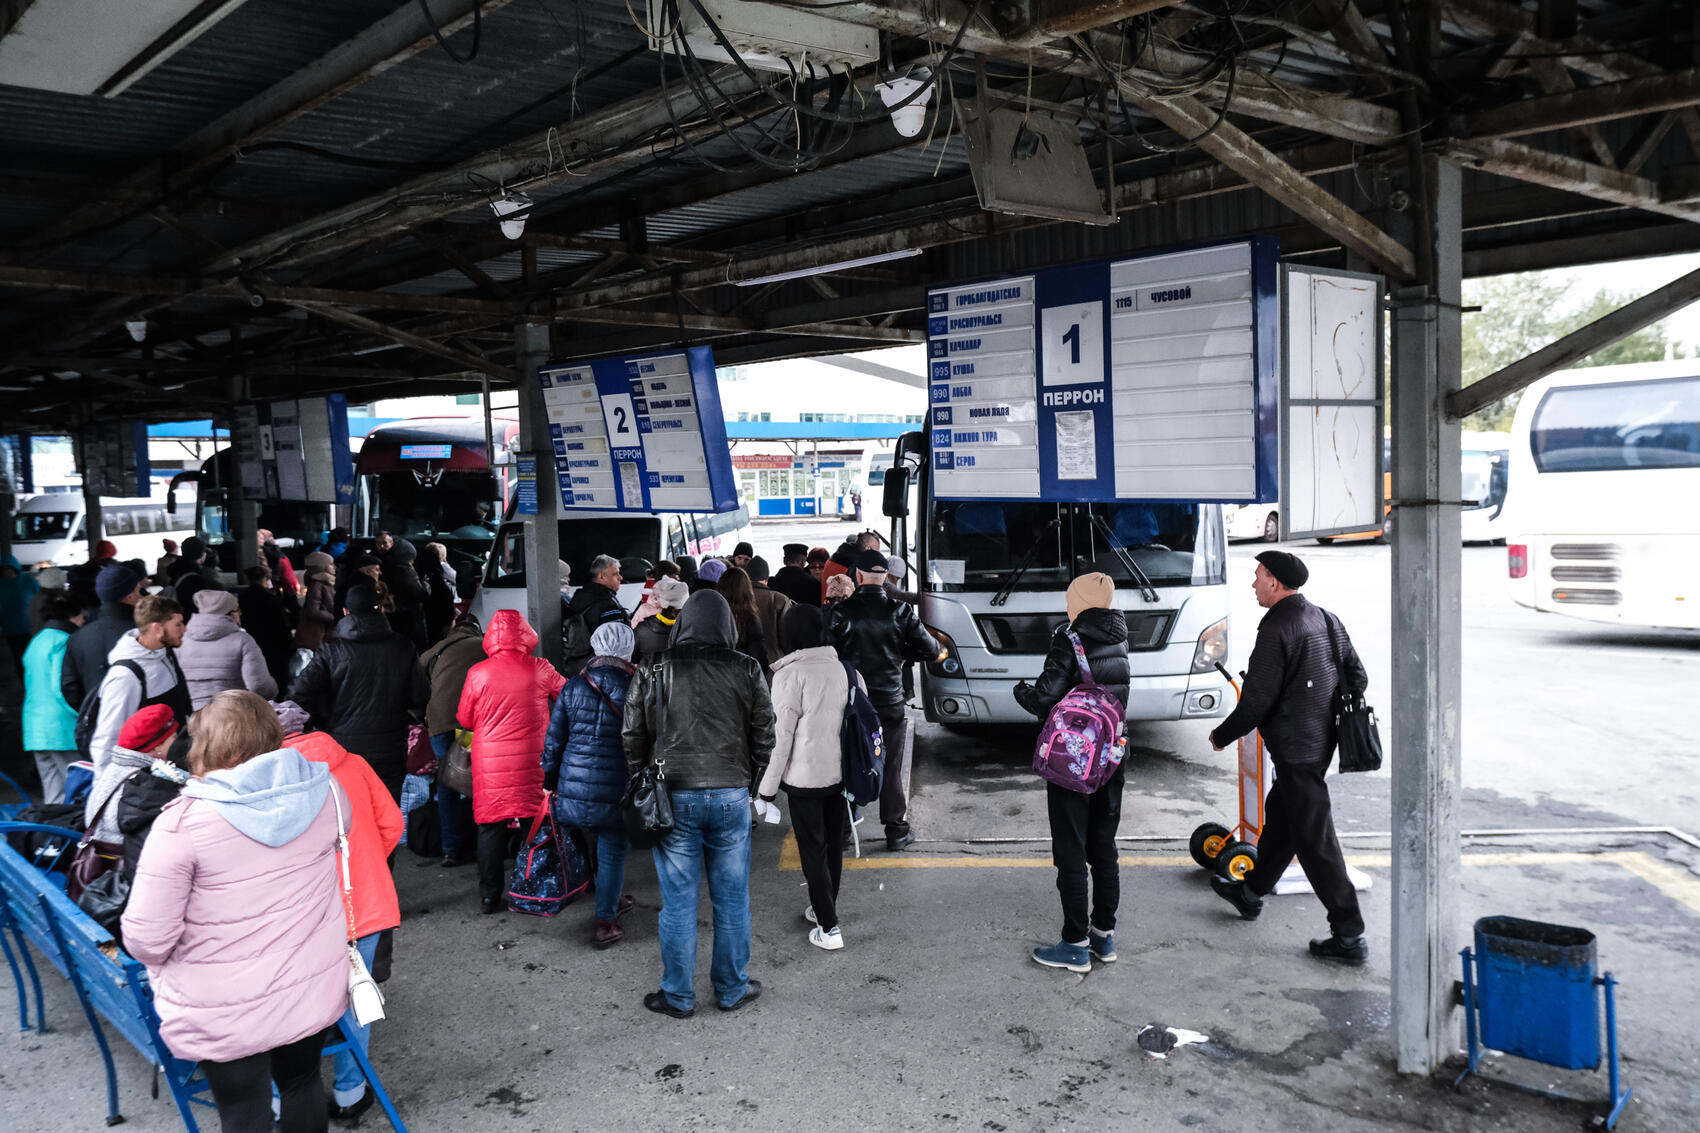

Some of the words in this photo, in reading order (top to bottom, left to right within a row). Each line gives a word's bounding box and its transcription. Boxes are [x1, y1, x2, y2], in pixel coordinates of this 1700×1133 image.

[956, 287, 1020, 306] ГОРОБЛАГОДАТСКАЯ
[1116, 296, 1132, 309] 1115
[1151, 286, 1191, 303] ЧУСОВОЙ
[950, 314, 1002, 330] КРАСНОУРАЛЬСК
[950, 339, 981, 352] КАЧКАНАР
[1062, 324, 1080, 364] 1
[935, 366, 949, 376] 995
[953, 363, 974, 375] КУШВА
[933, 388, 947, 398] 990
[1043, 389, 1105, 406] ПЕРРОН
[613, 407, 630, 433] 2
[937, 411, 949, 421] 990
[969, 408, 990, 418] НОВАЯ
[935, 433, 949, 444] 824
[982, 431, 998, 442] ТУРА
[613, 449, 642, 460] ПЕРРОН
[956, 456, 975, 466] СЕРОВ
